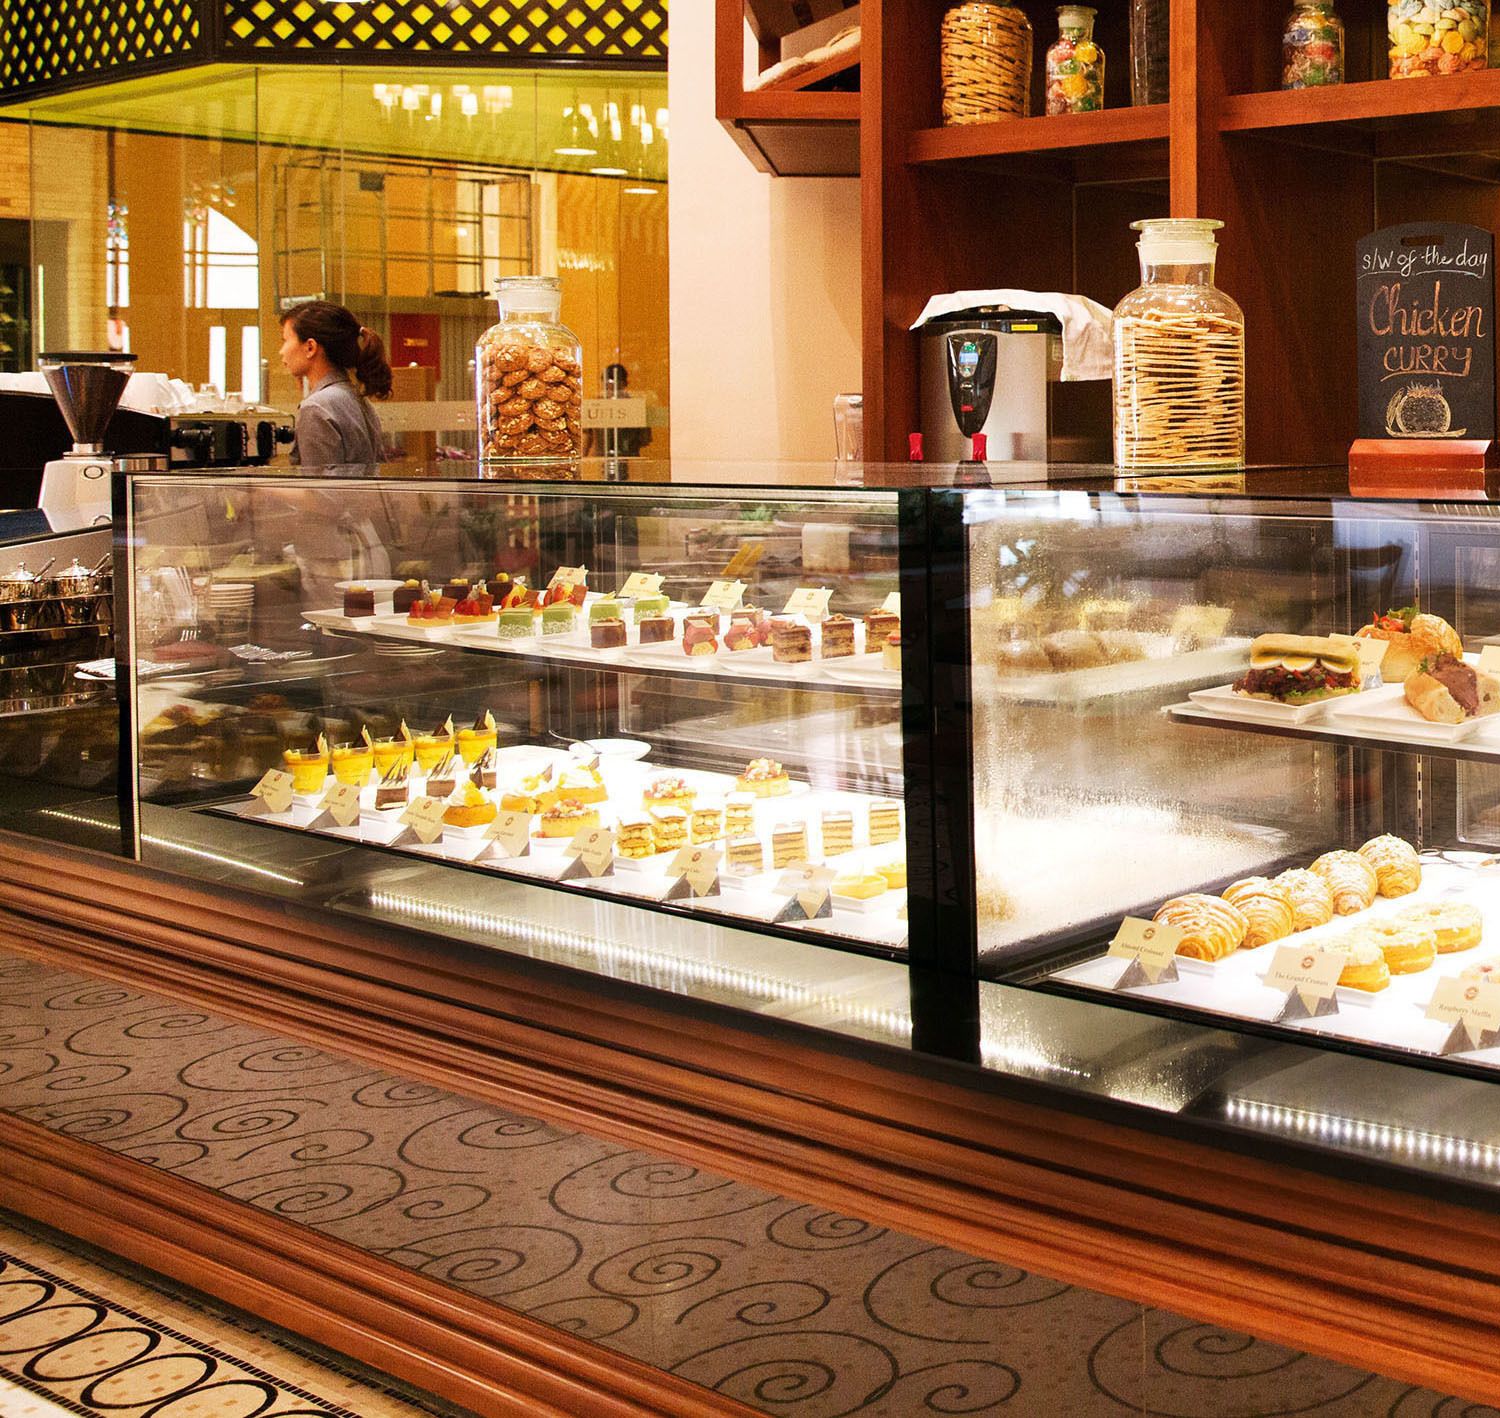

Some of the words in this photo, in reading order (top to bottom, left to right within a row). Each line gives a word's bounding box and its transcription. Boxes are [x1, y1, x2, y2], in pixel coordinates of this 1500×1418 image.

[1396, 249, 1418, 278] of
[1420, 245, 1453, 266] the
[1455, 237, 1488, 279] day
[1368, 279, 1487, 338] Chicken
